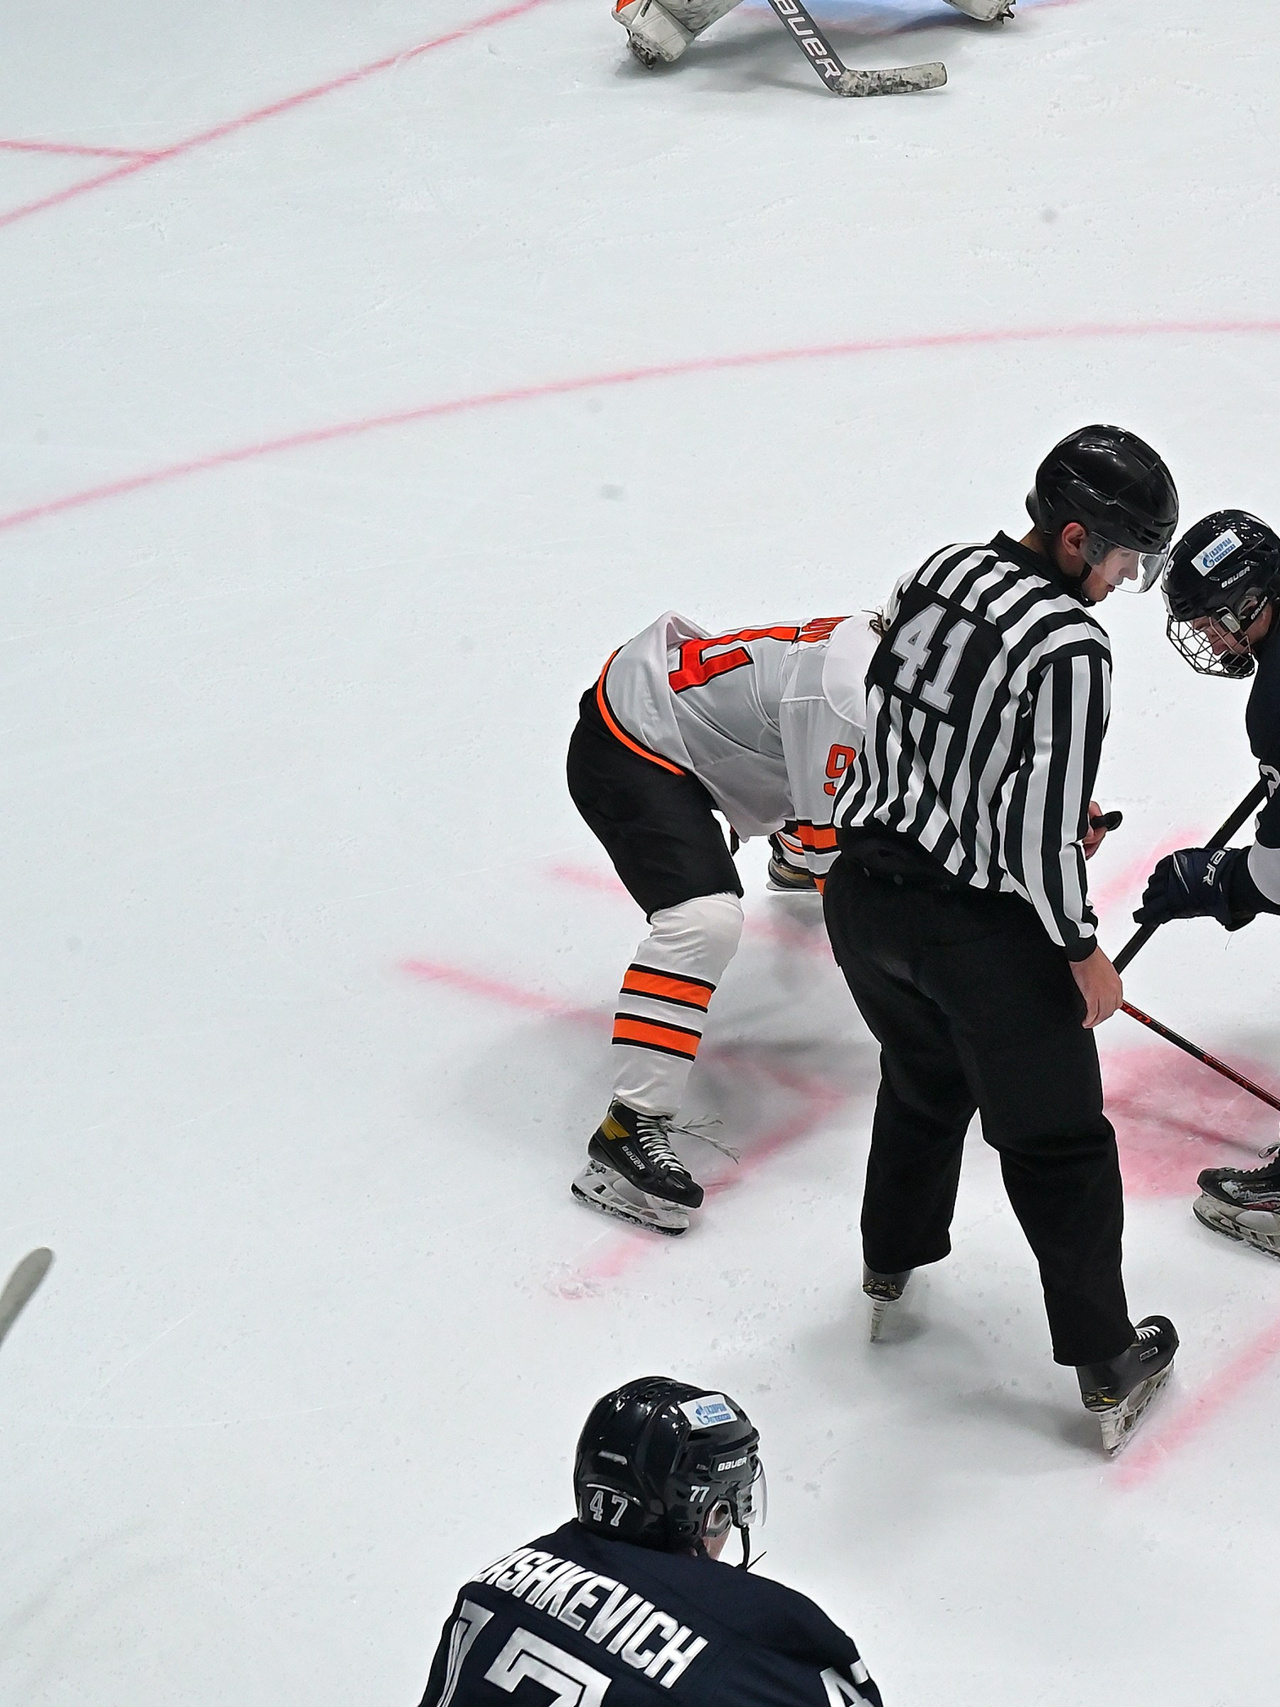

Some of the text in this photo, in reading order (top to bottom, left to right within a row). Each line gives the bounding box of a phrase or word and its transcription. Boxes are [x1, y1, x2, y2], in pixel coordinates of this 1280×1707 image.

[774, 0, 842, 79] AUER
[890, 602, 977, 715] 41
[718, 1457, 748, 1472] BAUER
[589, 1490, 628, 1527] 47
[689, 1486, 711, 1503] 77
[463, 1547, 709, 1689] ASHKEVICH
